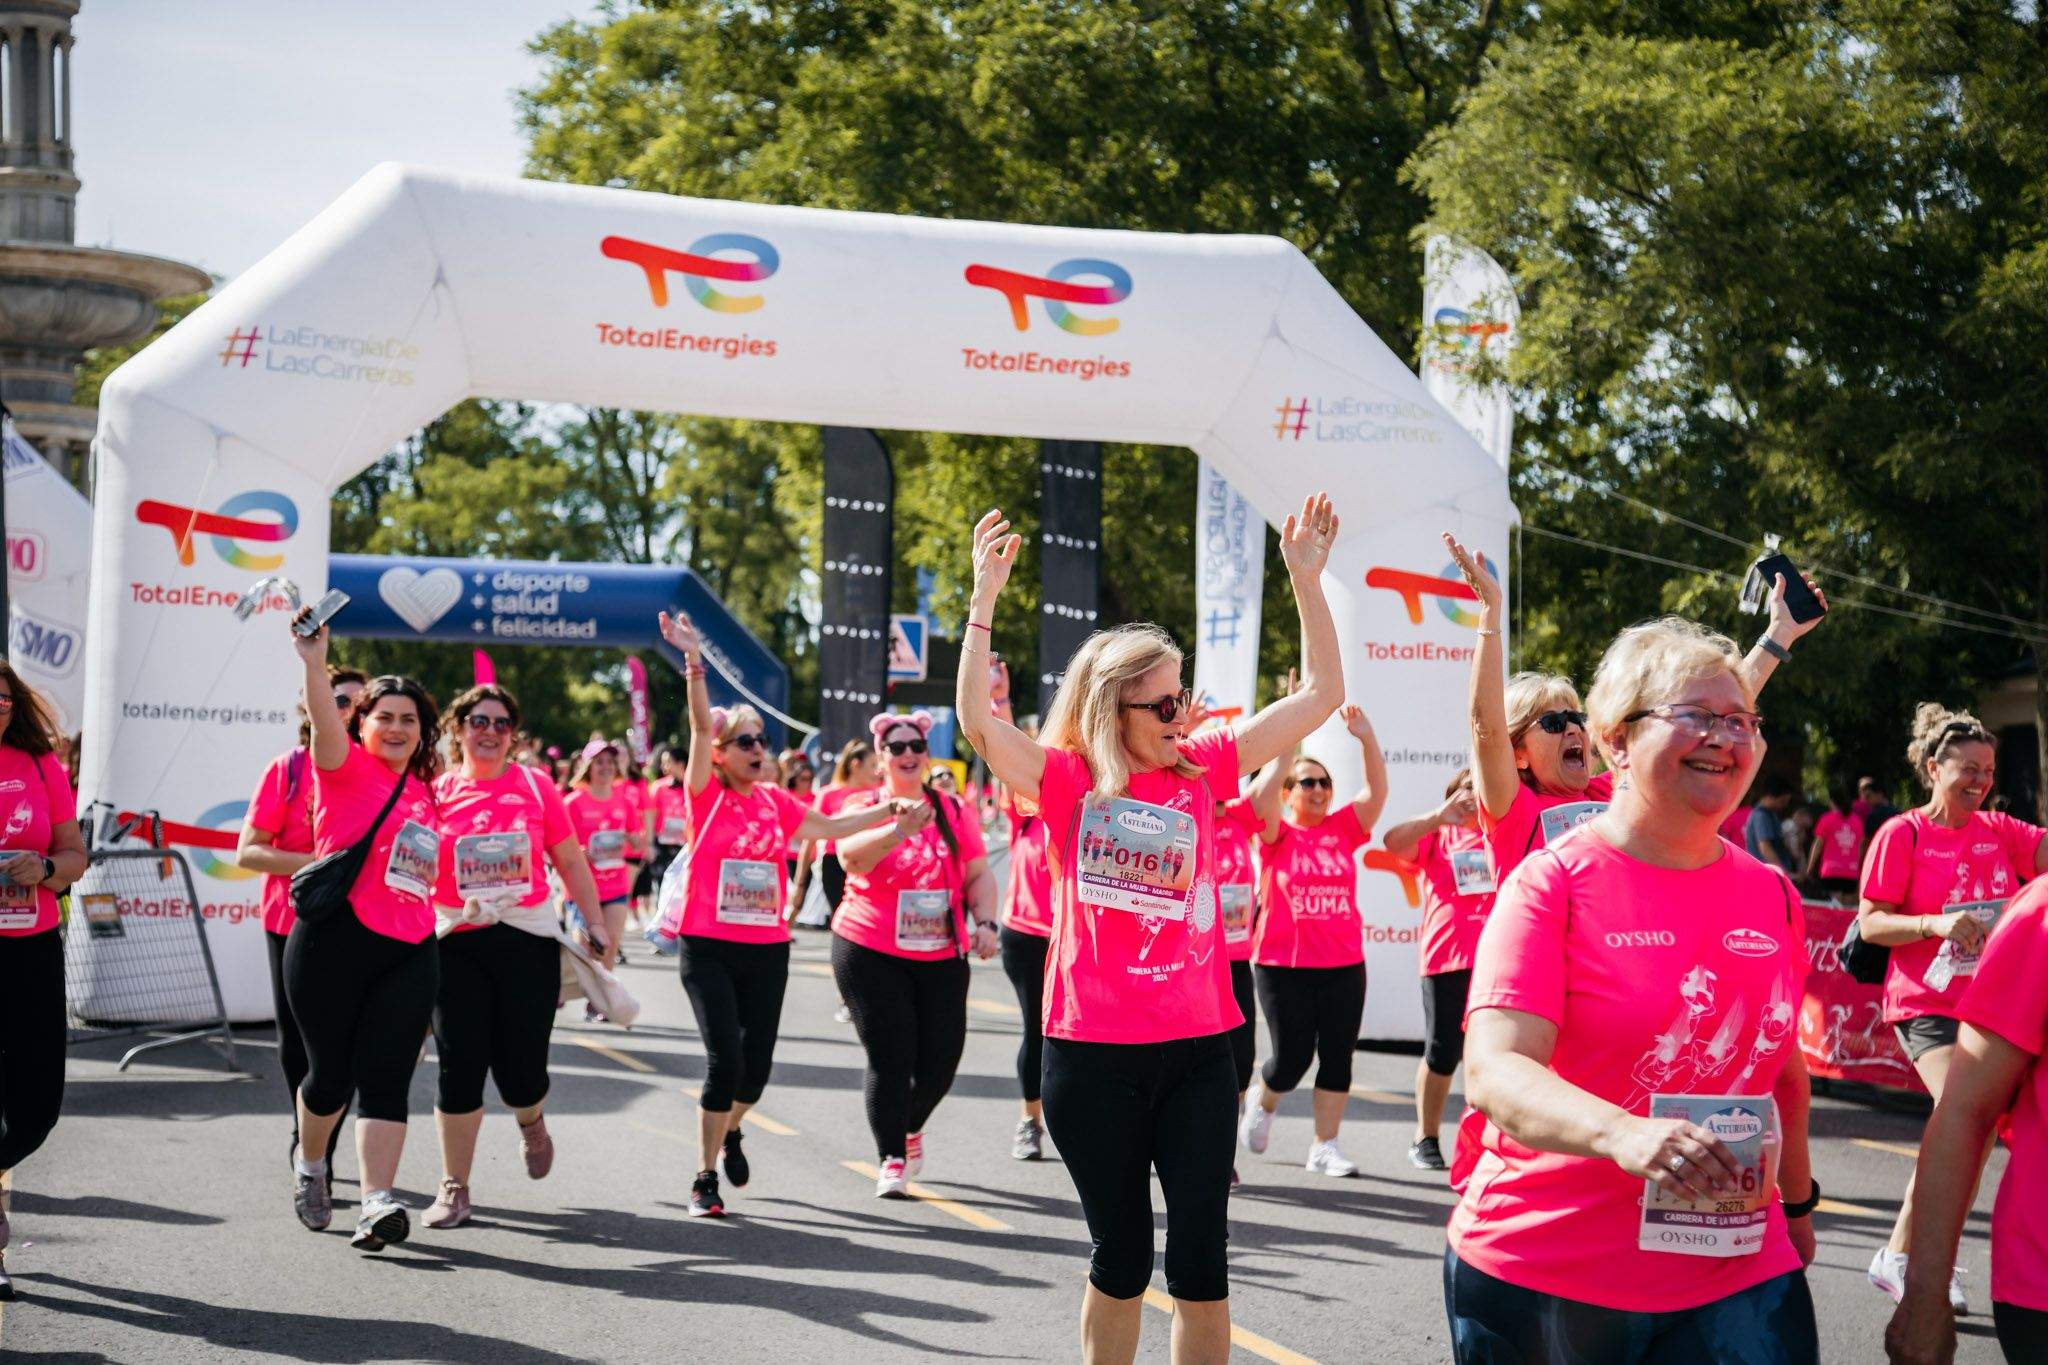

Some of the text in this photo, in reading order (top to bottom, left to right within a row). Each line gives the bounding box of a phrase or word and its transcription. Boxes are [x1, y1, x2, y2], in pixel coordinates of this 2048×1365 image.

[596, 323, 776, 359] TotalEnergies
[266, 349, 415, 386] LasCarreras
[962, 348, 1131, 381] TotalEnergies
[492, 570, 590, 595] deporte
[492, 592, 559, 615] salud
[492, 615, 597, 639] felicidad
[123, 702, 288, 724] totalenergies.es
[1120, 814, 1163, 832] ASTURIANA
[1115, 848, 1159, 871] 016
[1084, 874, 1110, 886] CARRERA
[1111, 880, 1120, 888] DE
[1129, 884, 1148, 893] MUJER
[1152, 888, 1174, 897] MADRID
[1120, 871, 1144, 882] 18221
[1081, 887, 1172, 912] OYSHO Santander
[1292, 896, 1351, 914] SUMA
[1363, 924, 1424, 943] Total
[1605, 930, 1676, 948] OYSHO
[1152, 973, 1168, 982] 2024
[1707, 1119, 1758, 1134] ASTURIANA
[1716, 1201, 1745, 1212] 26276
[1665, 1213, 1703, 1224] CARRERA
[1706, 1216, 1718, 1225] DE
[1720, 1217, 1729, 1226] LA
[1662, 1231, 1717, 1246] OYSHO
